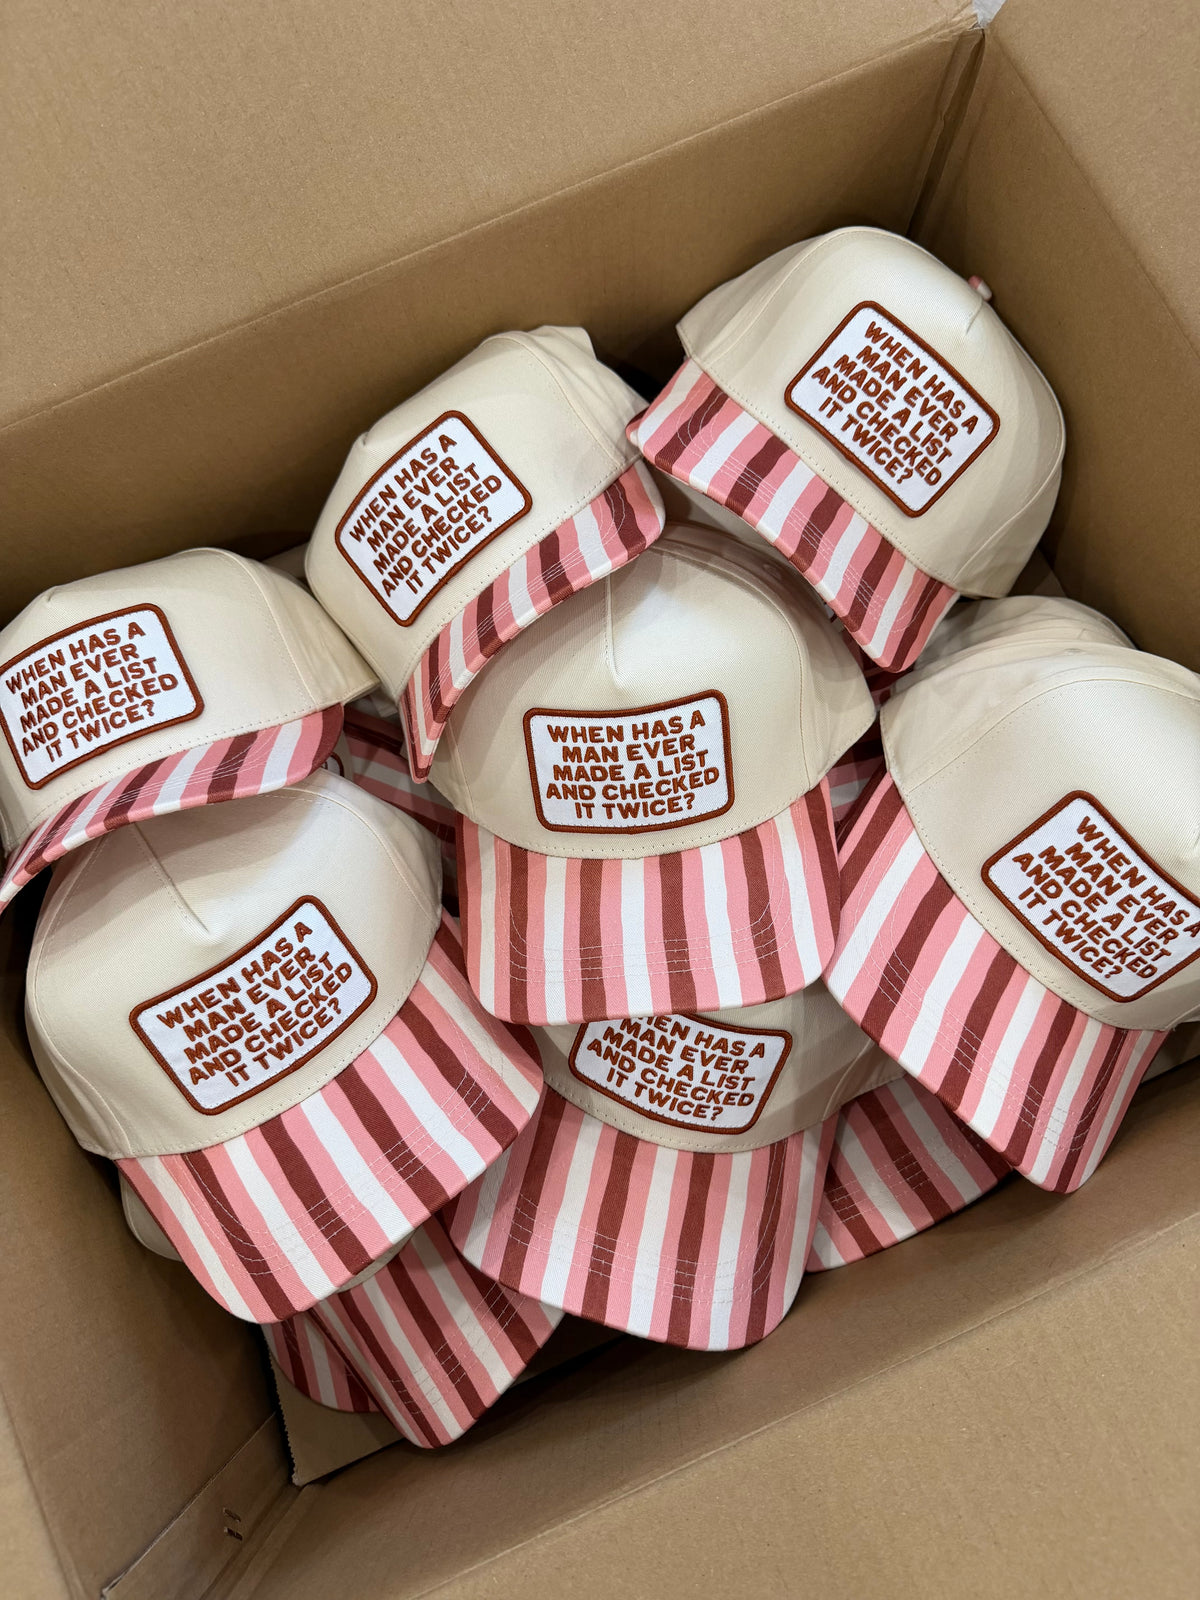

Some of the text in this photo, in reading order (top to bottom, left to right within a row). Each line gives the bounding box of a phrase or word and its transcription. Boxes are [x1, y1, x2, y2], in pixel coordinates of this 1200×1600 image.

[833, 355, 952, 464] MADE A LIST
[856, 346, 958, 442] MAN EVER
[864, 321, 978, 435] WHEN HAS A
[811, 366, 942, 486] AND CHECKED
[818, 397, 913, 484] IT TWICE?
[349, 434, 457, 542] WHEN HAS A
[367, 457, 460, 552] MAN EVER
[373, 463, 480, 575] MADE A LIST
[382, 475, 502, 597] AND CHECKED
[406, 506, 492, 594] IT TWICE?
[6, 622, 145, 694] WHEN HAS A
[20, 657, 156, 733] MADE A LIST
[21, 643, 139, 710] MAN EVER
[22, 673, 178, 757] AND CHECKED
[46, 699, 154, 762] IT TWICE?
[547, 710, 705, 743] WHEN HAS A
[562, 734, 695, 763] MAN EVER
[546, 767, 719, 800] AND CHECKED
[553, 750, 708, 781] MADE A LIST
[575, 793, 695, 819] IT TWICE?
[1012, 853, 1157, 979] AND CHECKED
[1038, 845, 1171, 961] MADE A LIST
[1065, 842, 1179, 945] MAN EVER
[1077, 816, 1200, 937] WHEN HAS A
[156, 922, 313, 1028] WHEN HAS A
[1018, 886, 1123, 978] IT TWICE?
[183, 946, 316, 1042] MAN EVER
[184, 951, 334, 1064] MADE A LIST
[189, 962, 352, 1085] AND CHECKED
[637, 1016, 765, 1058] EN HAS A
[225, 997, 341, 1087] IT TWICE?
[587, 1038, 754, 1107] AND CHECKED
[603, 1027, 755, 1091] MADE A LIST
[620, 1018, 748, 1074] MAN EVER
[606, 1068, 724, 1121] IT TWICE?
